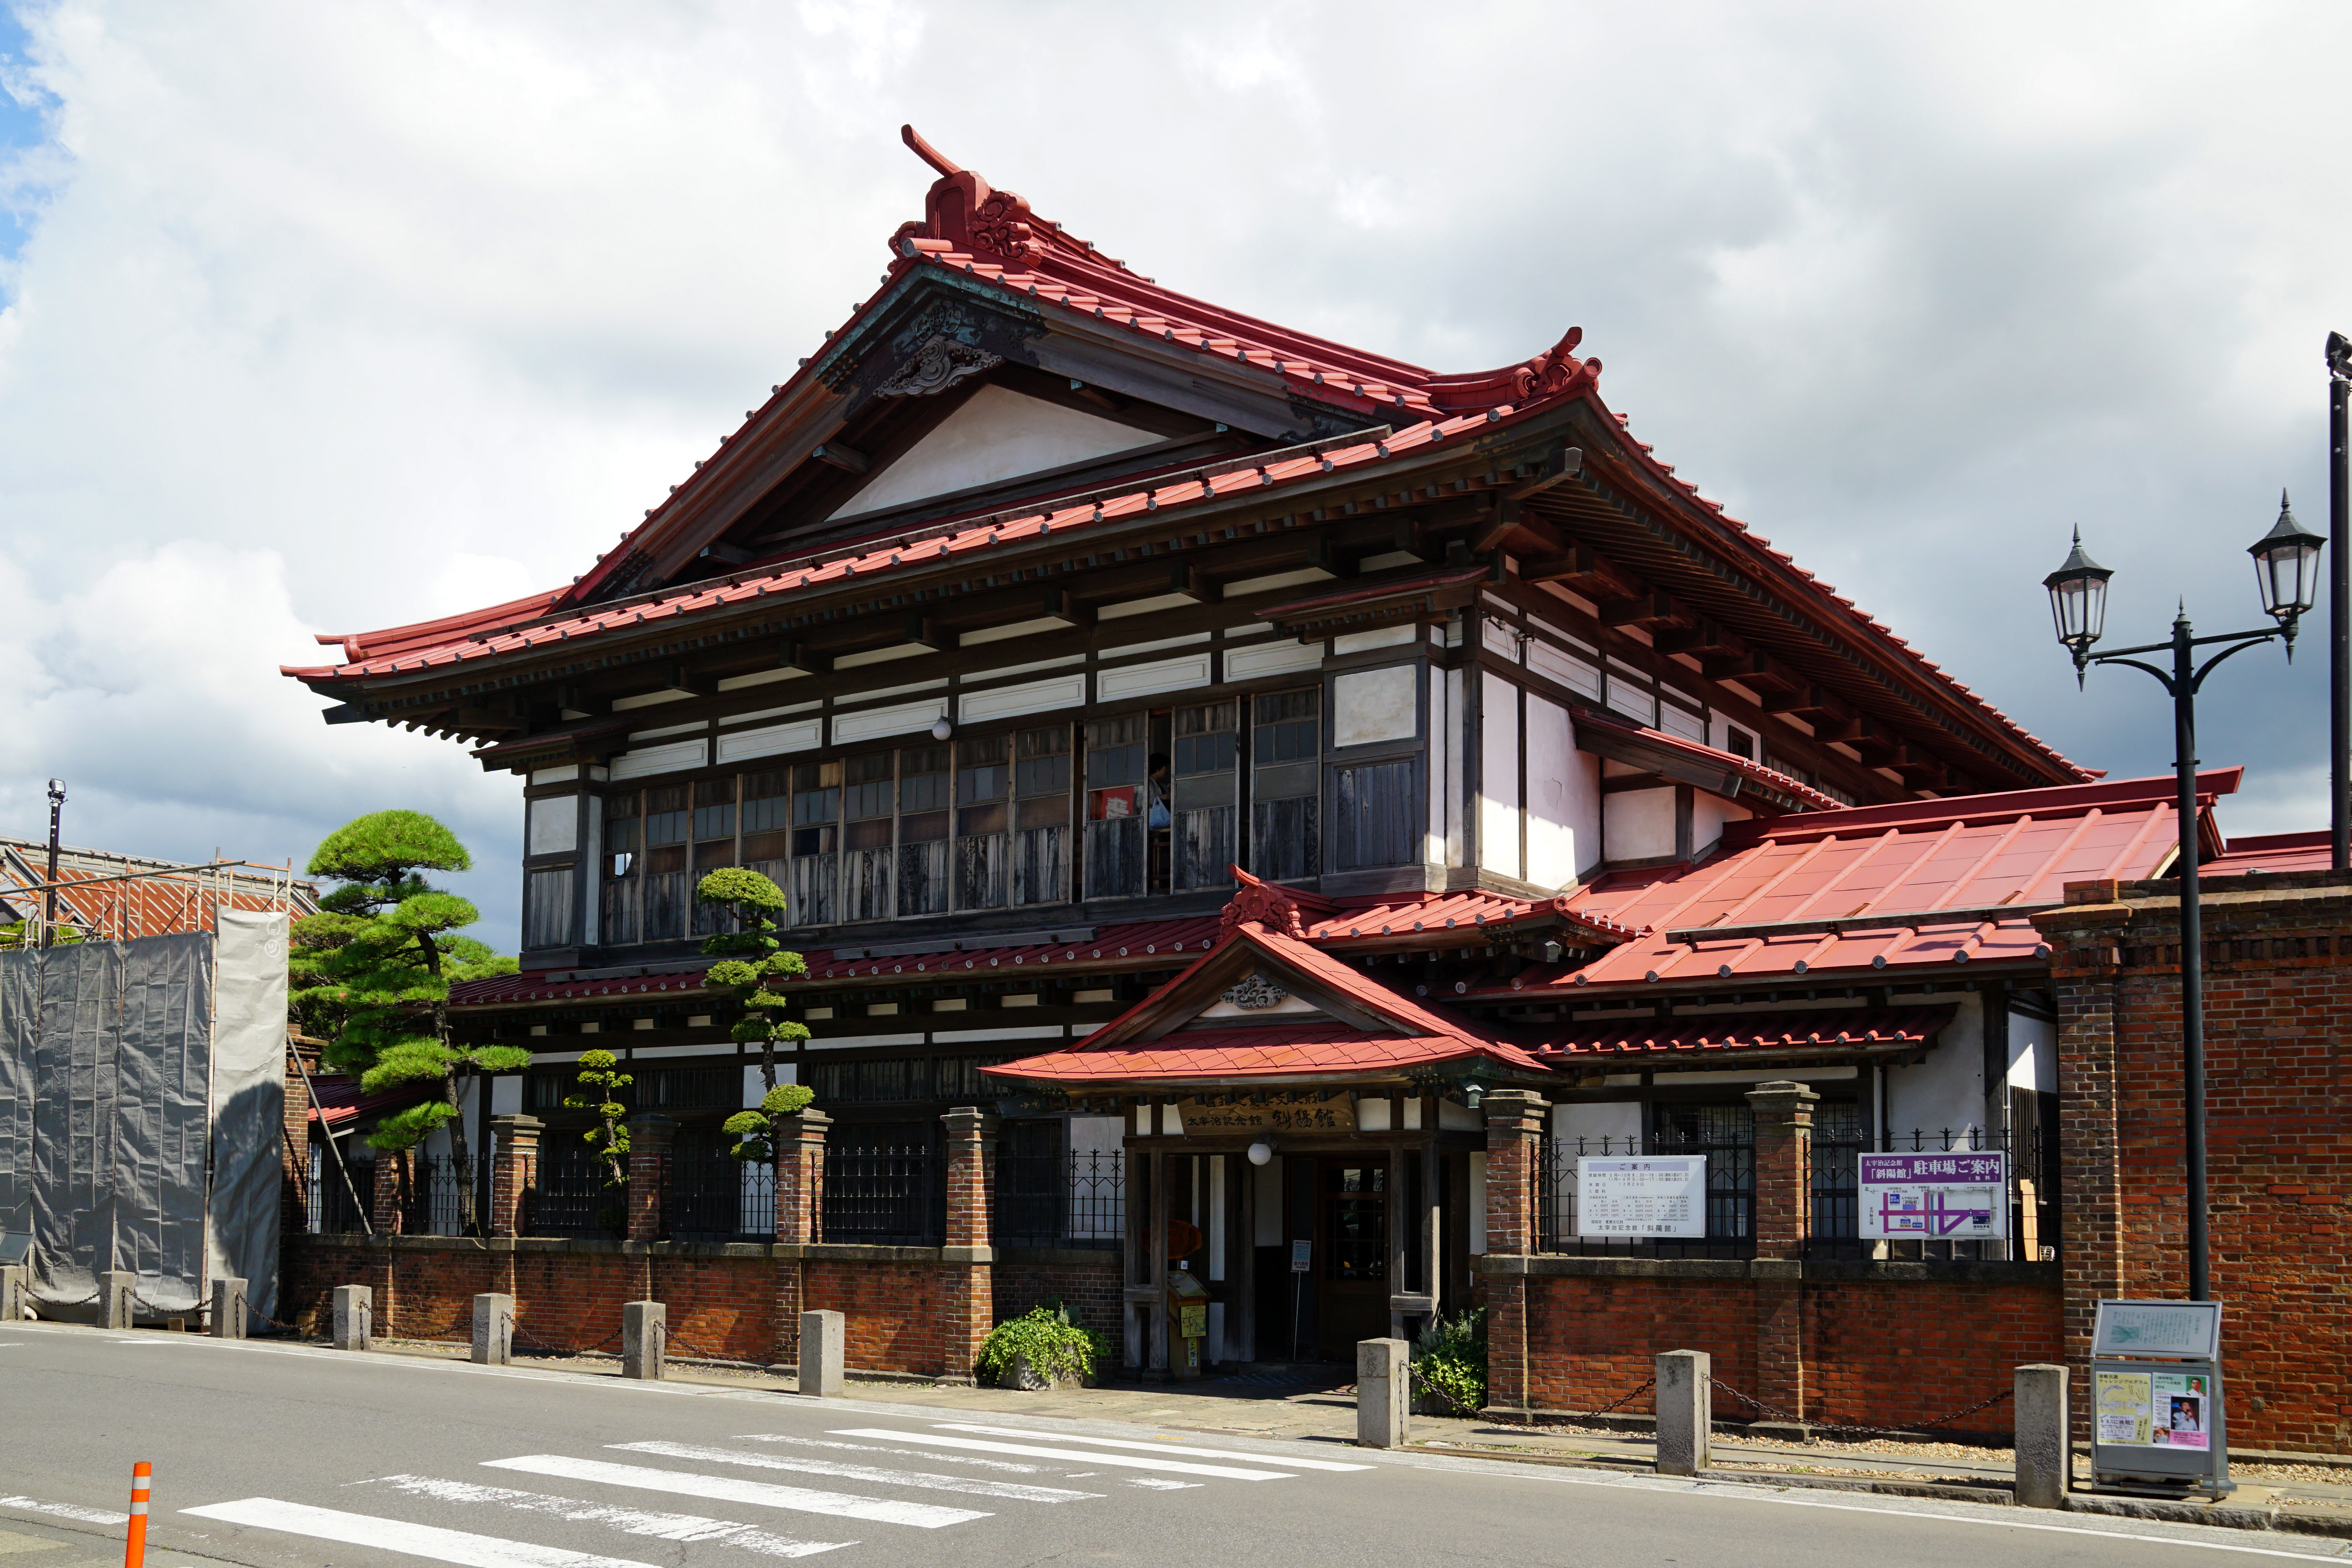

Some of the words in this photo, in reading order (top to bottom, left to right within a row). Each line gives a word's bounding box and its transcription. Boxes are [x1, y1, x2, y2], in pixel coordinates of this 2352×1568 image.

[1188, 1115, 1262, 1127] 太宰治記念館
[1272, 1108, 1336, 1129] 斜陽館
[1871, 1168, 1911, 1179] 「斜陽館」
[1913, 1159, 2000, 1175] 駐車場ご案内
